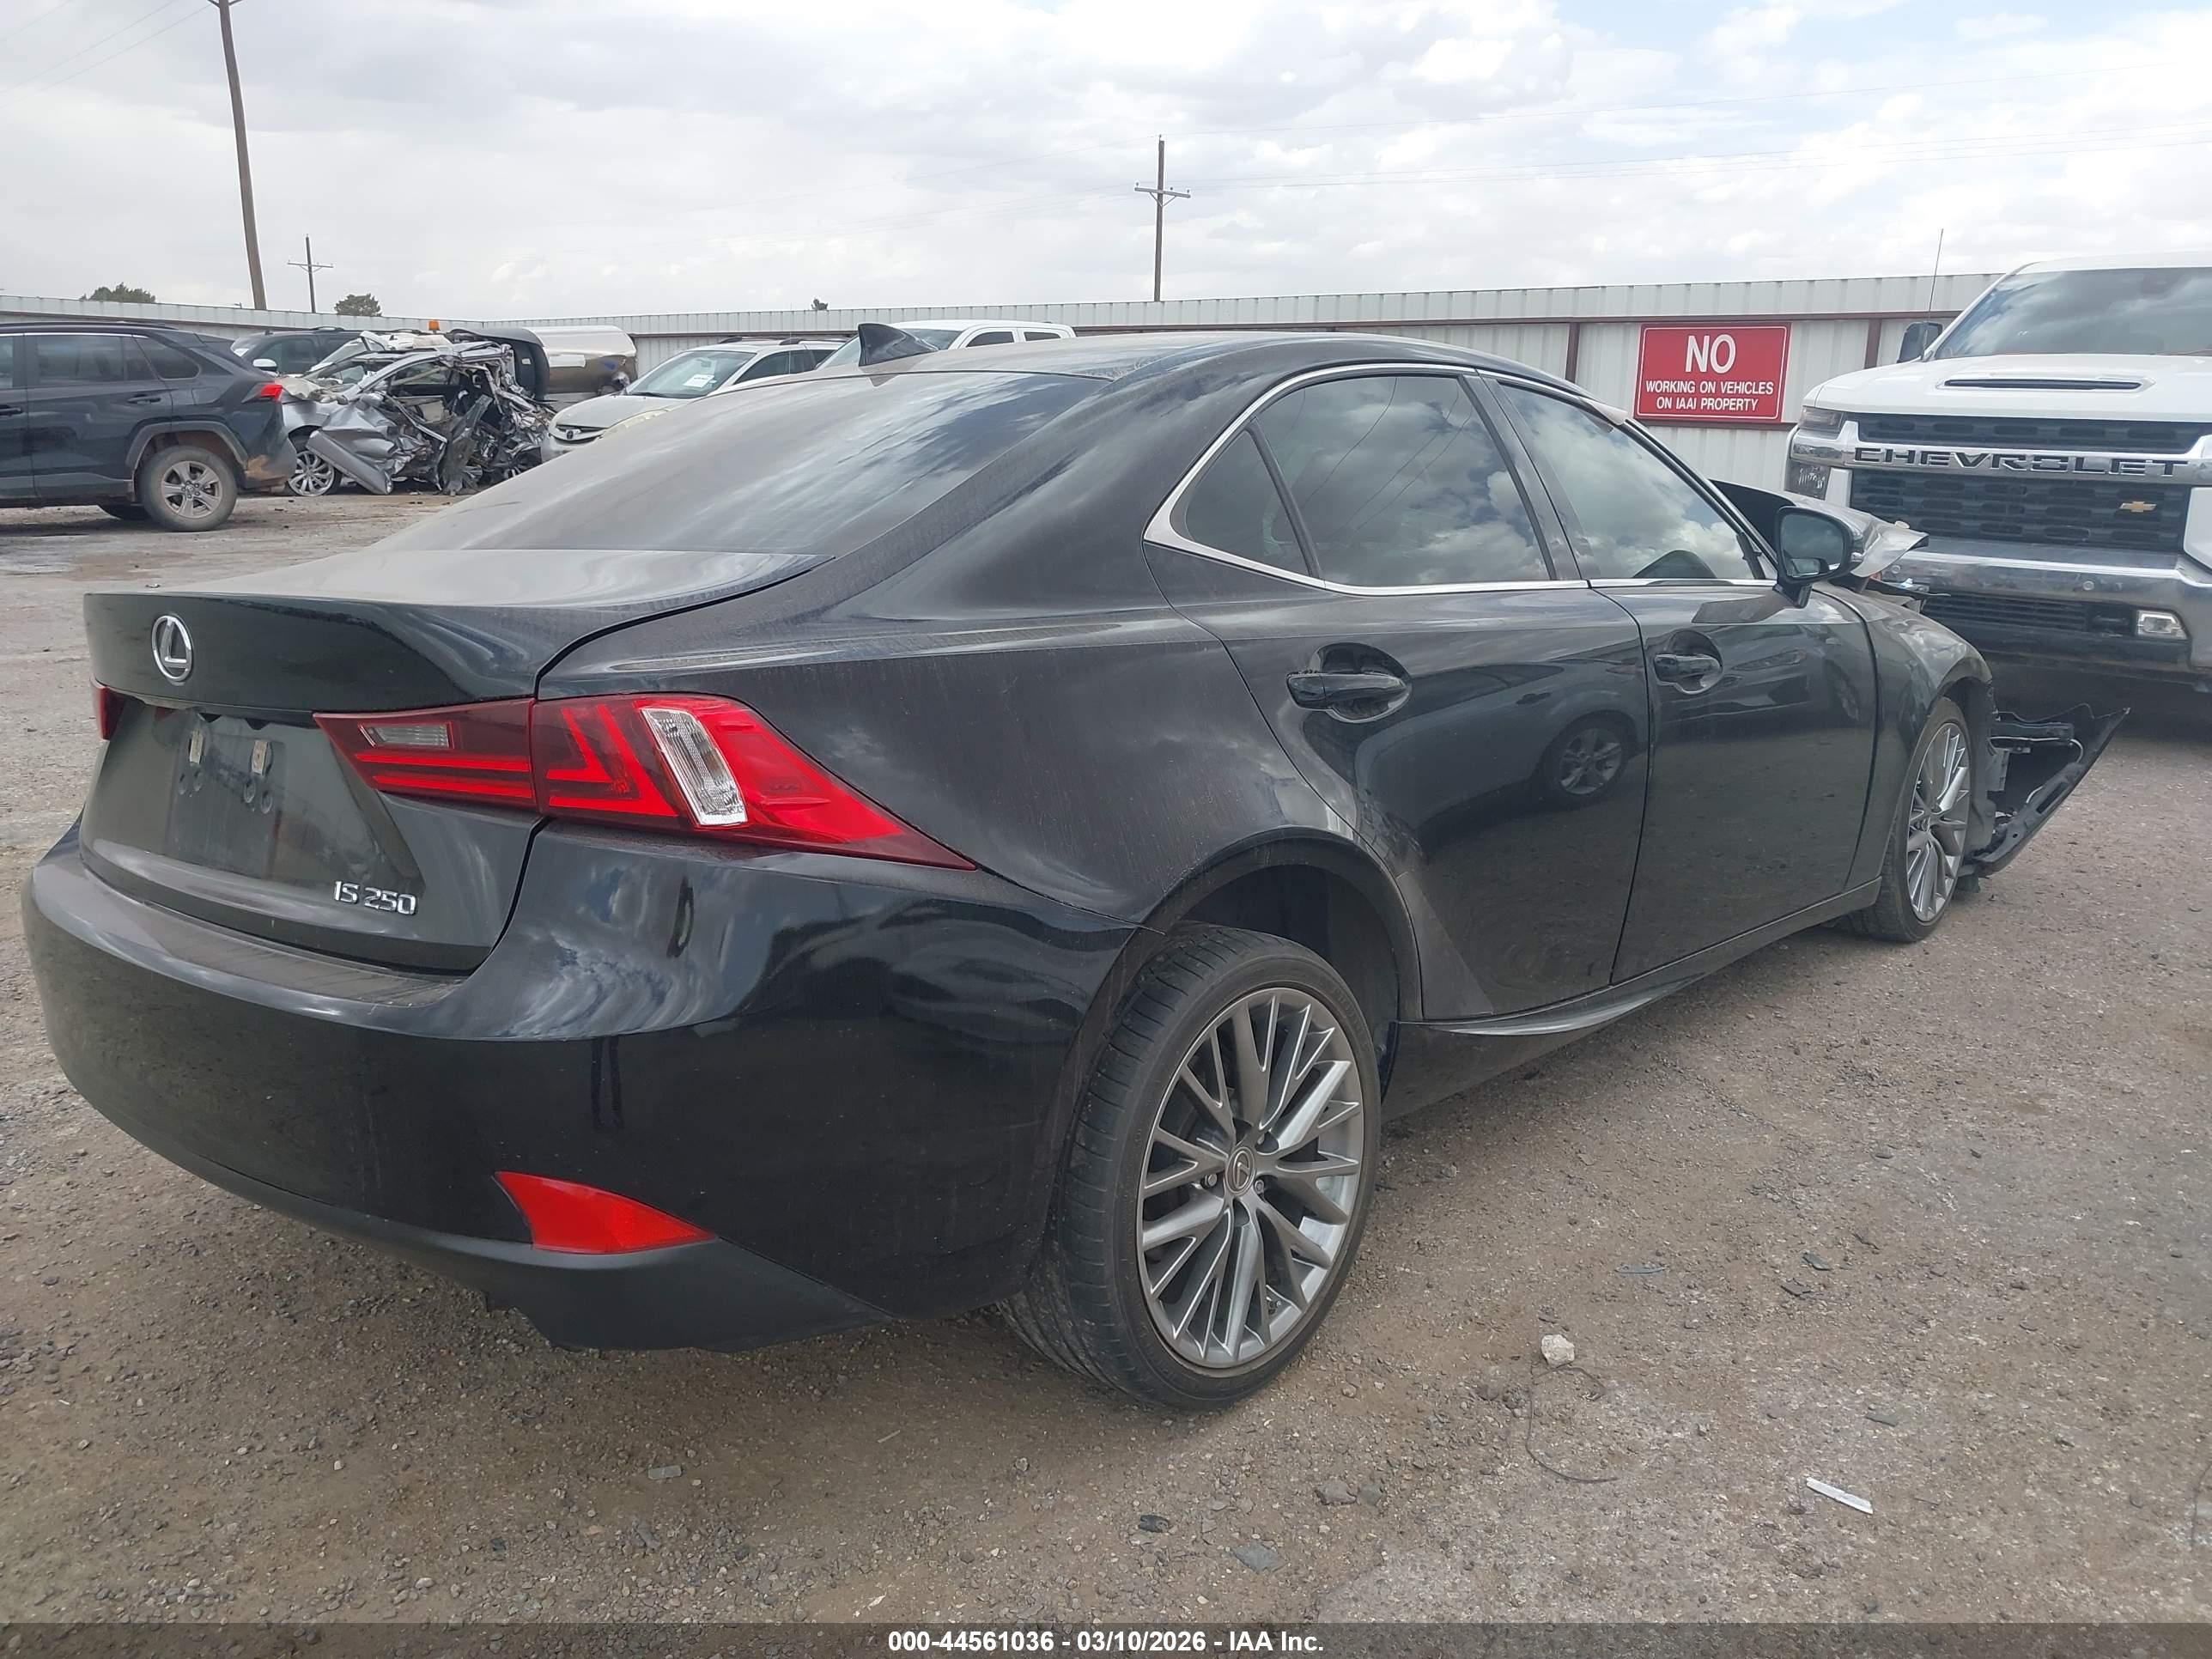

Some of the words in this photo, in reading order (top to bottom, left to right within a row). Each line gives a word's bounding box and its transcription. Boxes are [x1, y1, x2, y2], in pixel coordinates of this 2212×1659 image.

[1685, 334, 1736, 374] NO
[1645, 380, 1696, 393] WORKING
[1699, 380, 1717, 394] ON
[1720, 381, 1774, 395] VEHICLES
[1656, 396, 1672, 409] ON
[1676, 397, 1697, 410] IAAI
[1700, 398, 1759, 411] PROPERTY
[1854, 447, 2190, 477] CHEVROLET
[334, 881, 360, 904] IS
[363, 887, 417, 915] 250
